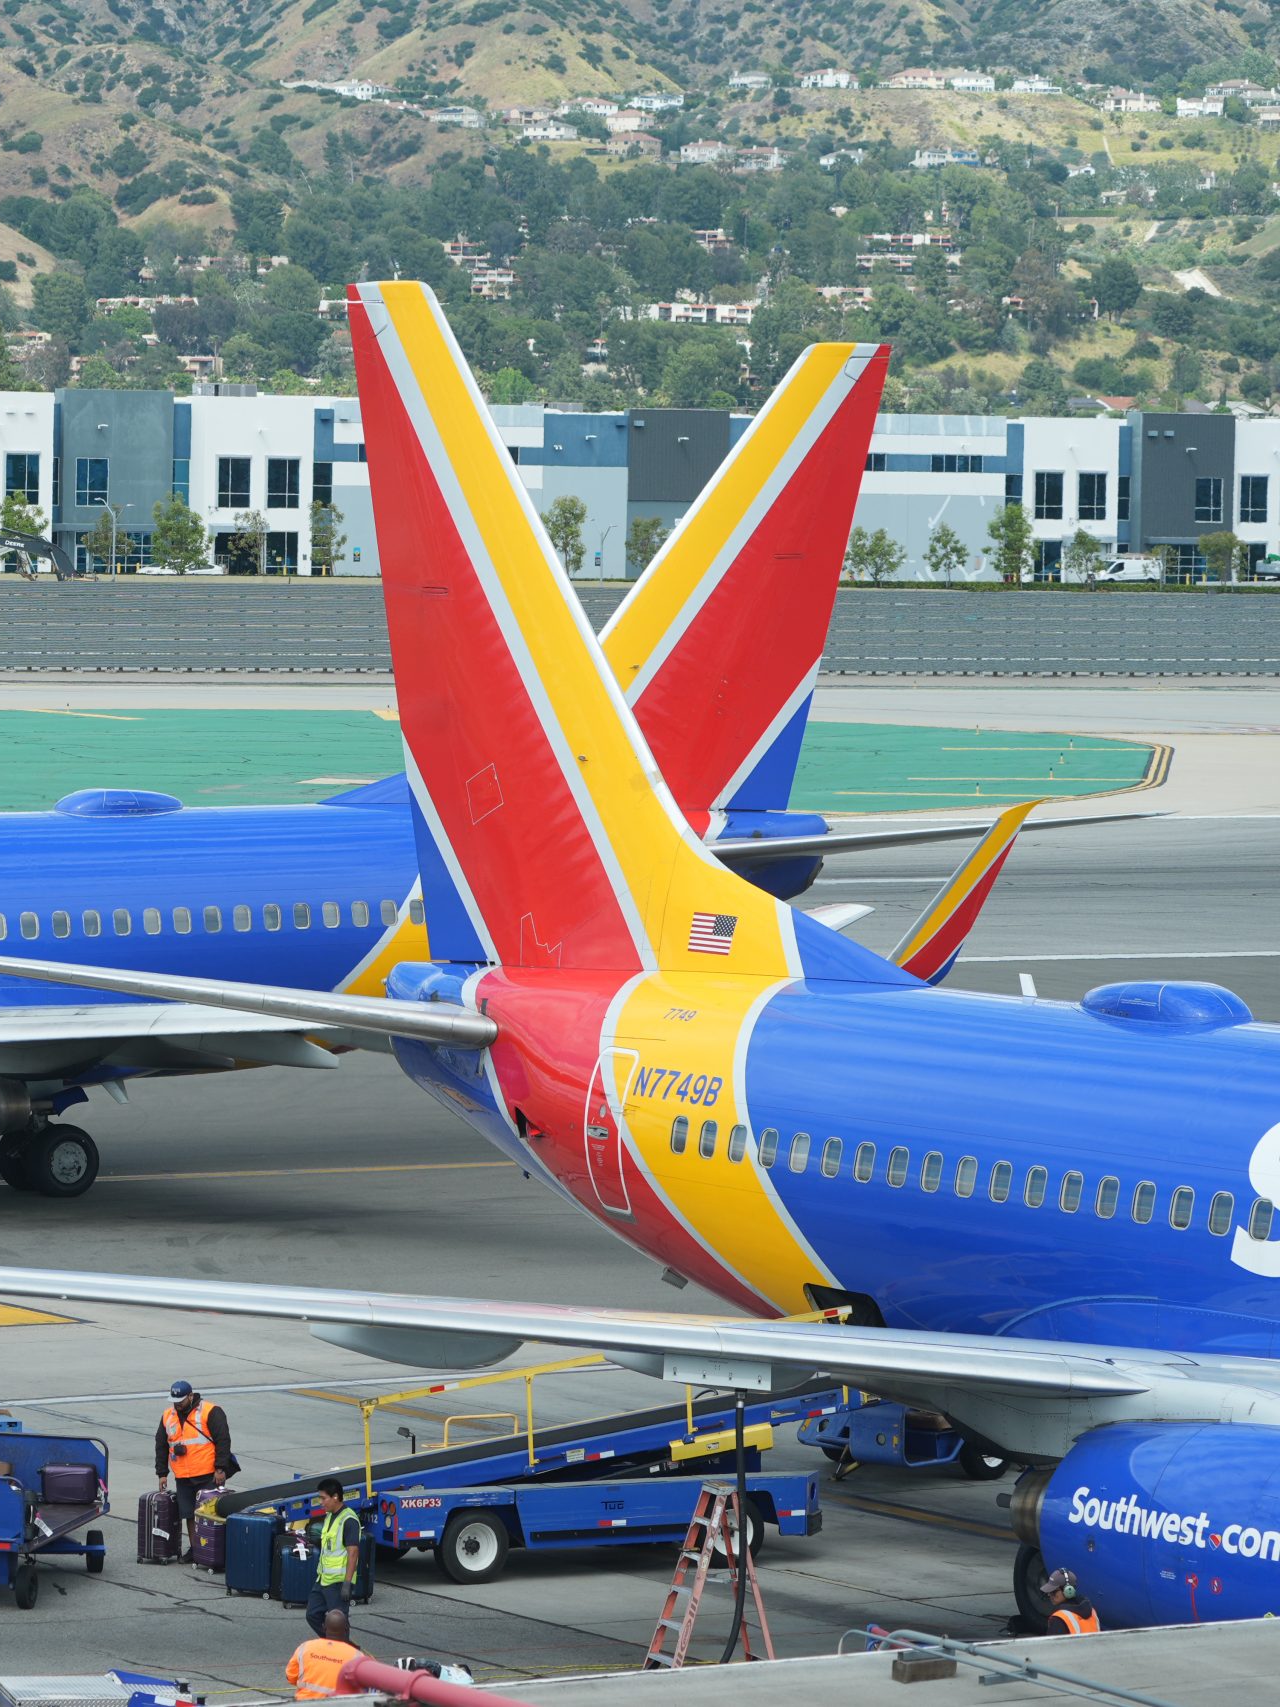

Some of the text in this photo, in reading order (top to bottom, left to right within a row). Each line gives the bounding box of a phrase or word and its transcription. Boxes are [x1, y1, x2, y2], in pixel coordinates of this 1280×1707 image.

[4, 540, 25, 548] DEERE
[663, 1007, 697, 1021] 7749
[632, 1066, 723, 1107] N7749B
[310, 1653, 343, 1664] Southwest
